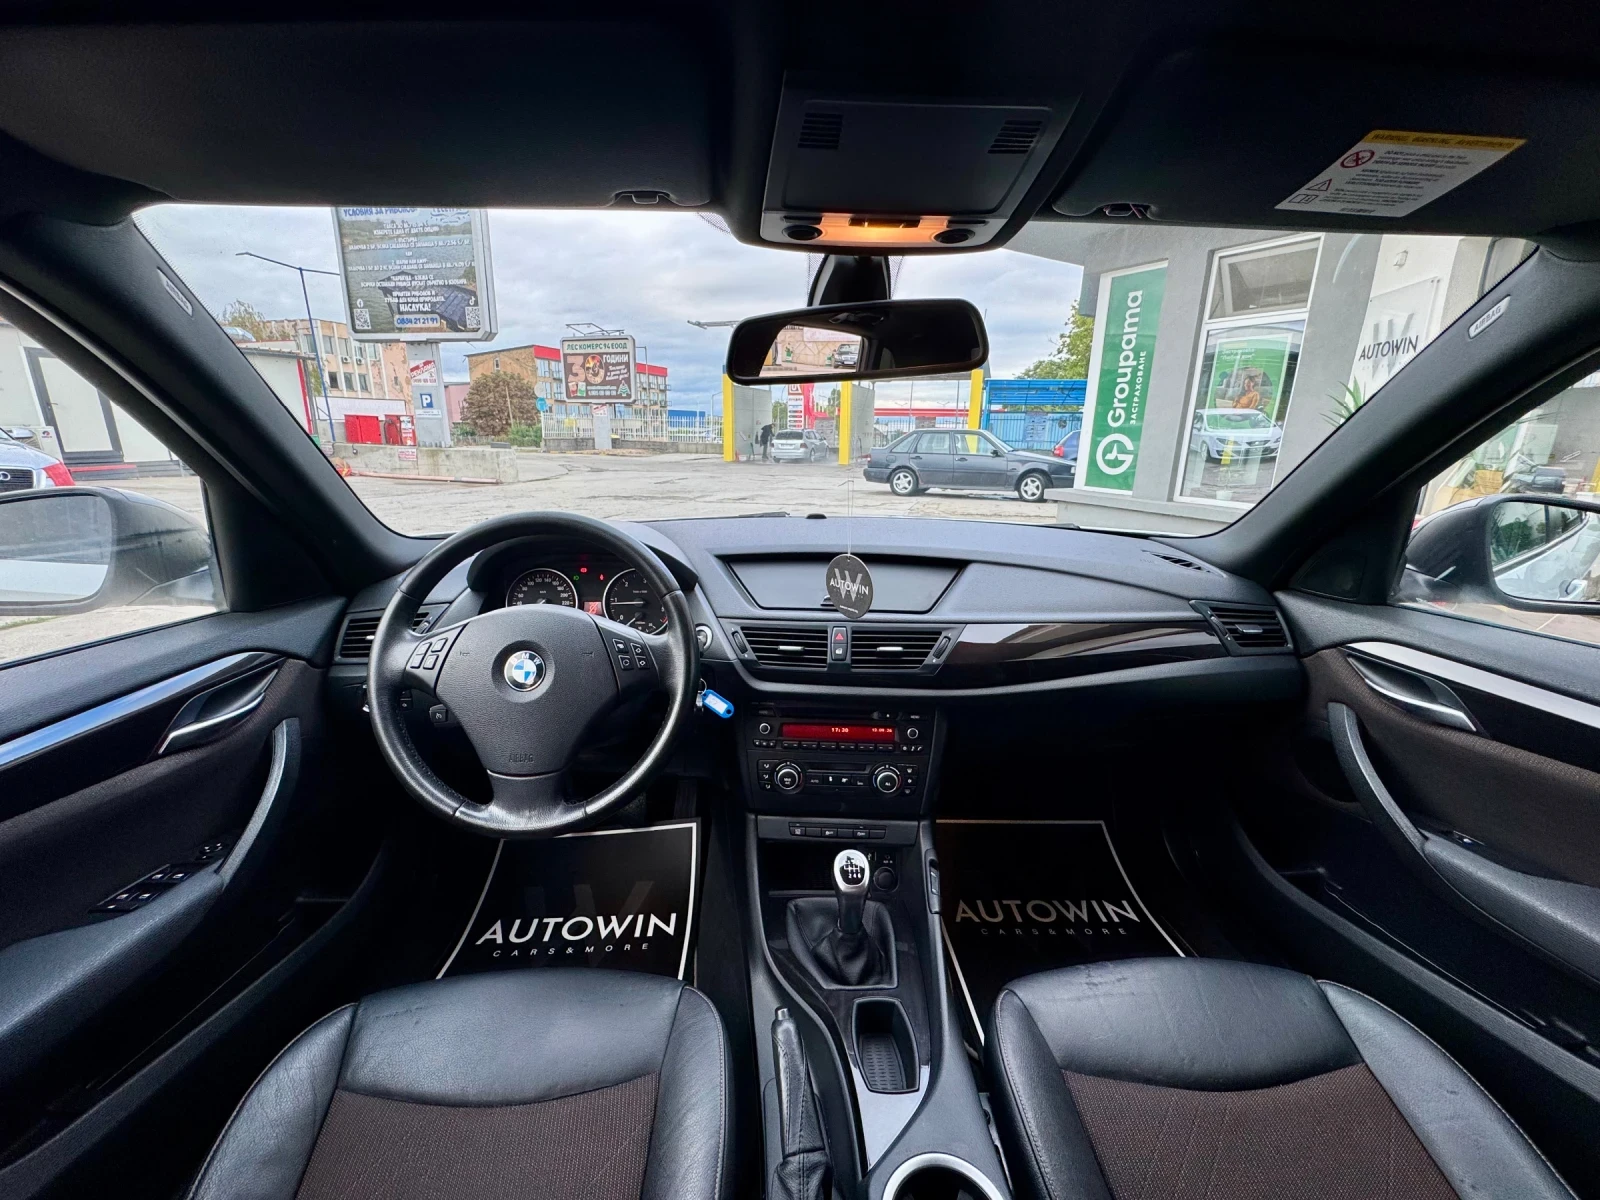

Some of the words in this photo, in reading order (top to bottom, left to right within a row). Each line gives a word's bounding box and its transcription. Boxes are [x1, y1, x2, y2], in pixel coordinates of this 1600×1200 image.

[399, 303, 431, 312] НАСЛУКА!
[413, 317, 421, 325] 21
[422, 317, 429, 325] 21
[1473, 305, 1502, 333] AIRBAG
[602, 354, 629, 363] ГОДИНИ
[1107, 289, 1143, 428] Groupama
[1358, 335, 1419, 361] AUTOWIN
[1129, 350, 1147, 425] ЗАСТРАХОВАНЕ
[422, 394, 431, 407] P
[829, 577, 869, 596] AUTOWIN
[955, 899, 1141, 923] AUTOWIN
[475, 912, 677, 945] AUTOWIN
[492, 942, 649, 957] CARS&MORE
